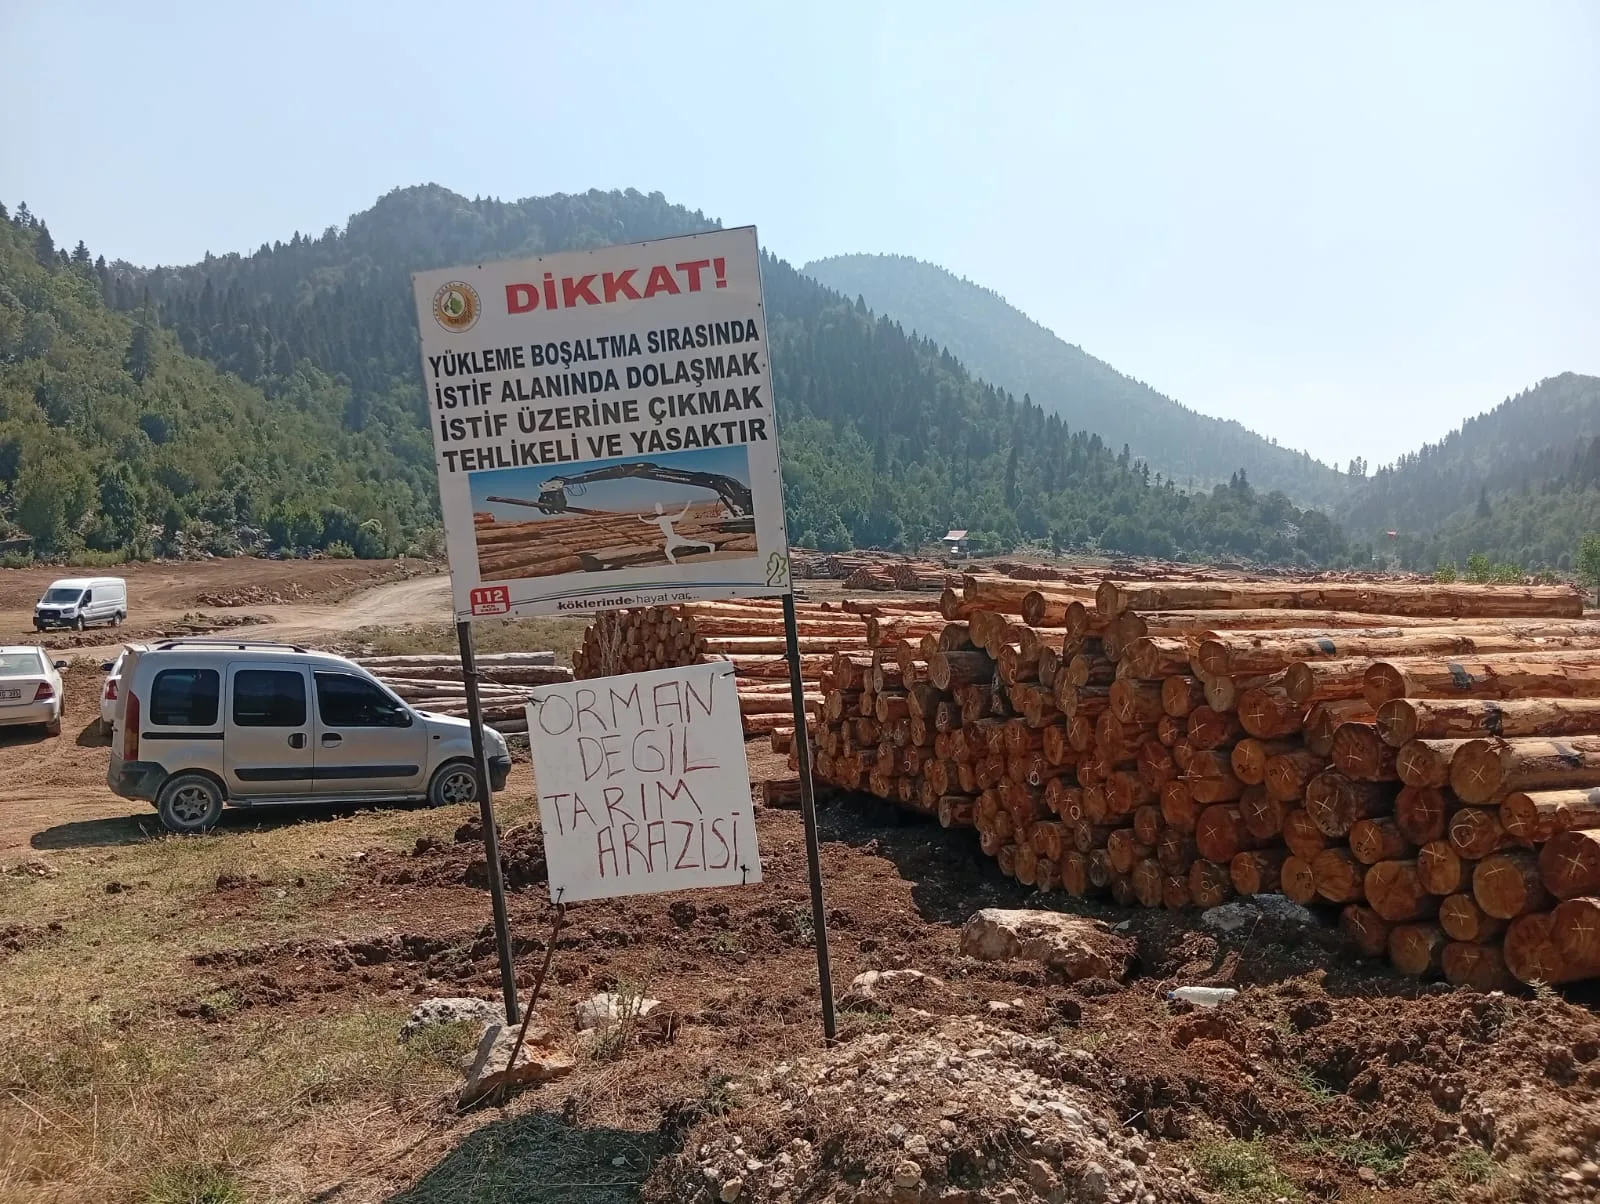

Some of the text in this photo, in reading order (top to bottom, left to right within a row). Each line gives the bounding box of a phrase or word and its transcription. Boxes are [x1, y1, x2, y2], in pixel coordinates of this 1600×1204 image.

[505, 257, 727, 315] DİKKAT!
[428, 319, 759, 378] YÜKLEME BOŞALTMA SIRASINDA
[435, 352, 761, 410] İSTİF ALANINDA DOLAŞMAK
[441, 385, 763, 442] İSTİF ÜZERİNE ÇIKMAK
[442, 418, 768, 473] TEHLİKELİ VE YASAKTIR
[474, 589, 504, 603] 112
[636, 592, 668, 605] hayat
[539, 672, 714, 735] ORMAN
[543, 779, 703, 836] TARIM
